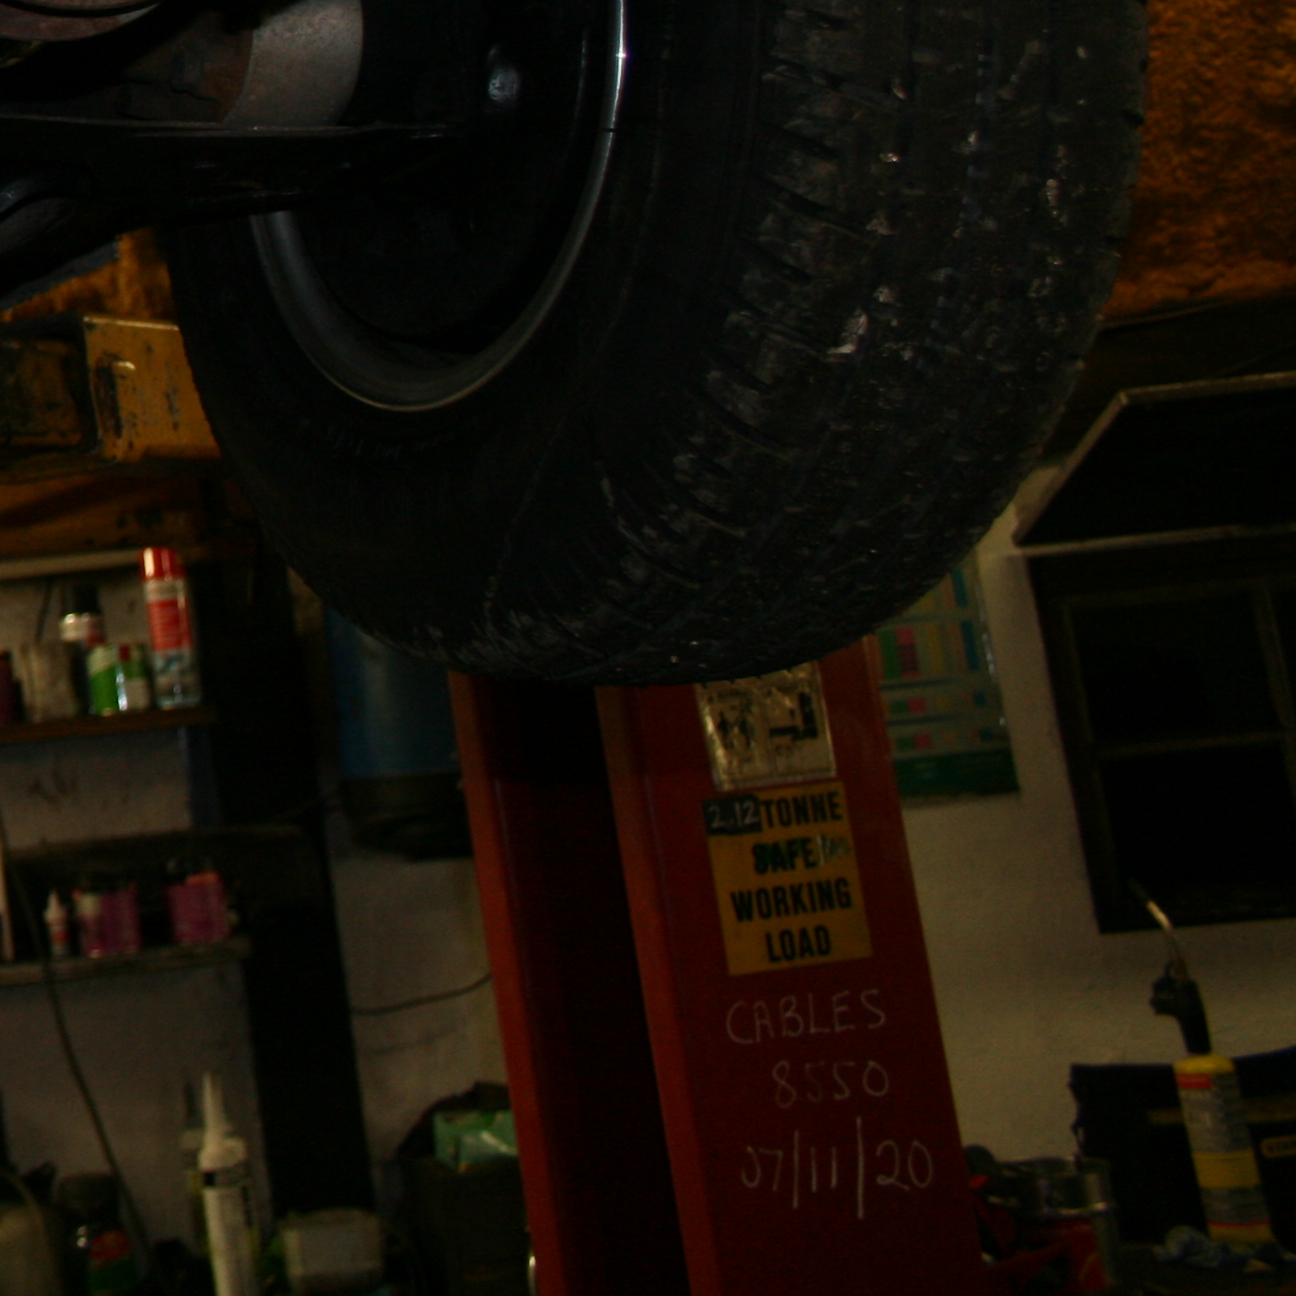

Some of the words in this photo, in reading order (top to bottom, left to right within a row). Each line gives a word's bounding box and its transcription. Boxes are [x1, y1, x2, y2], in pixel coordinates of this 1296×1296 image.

[760, 791, 842, 828] TONNE
[731, 878, 852, 922] WORKING
[766, 925, 831, 963] LOAD
[725, 988, 887, 1044] CABLES
